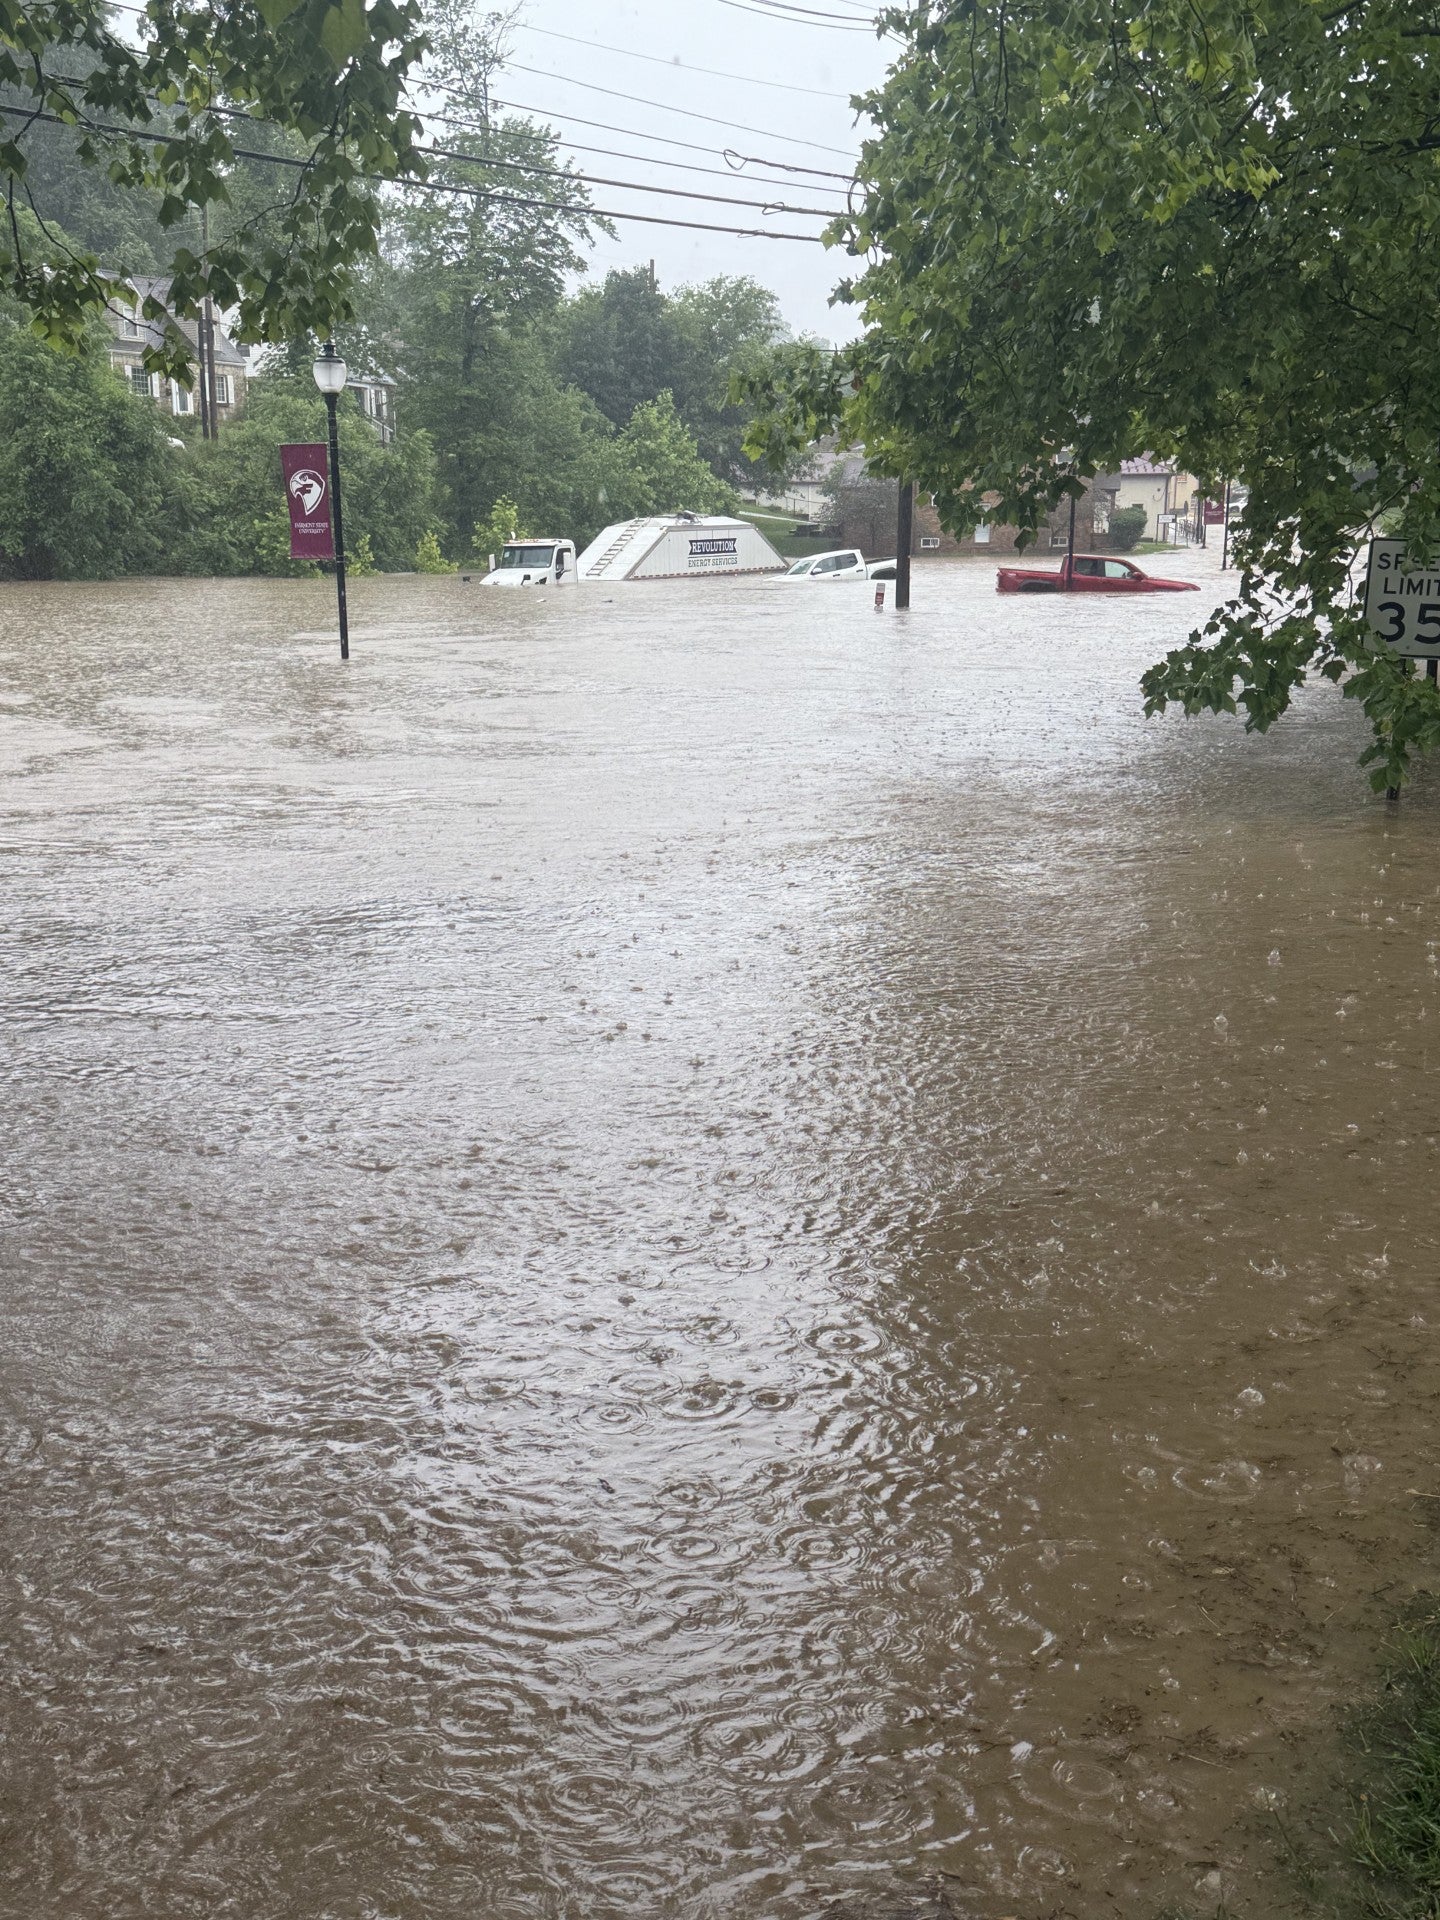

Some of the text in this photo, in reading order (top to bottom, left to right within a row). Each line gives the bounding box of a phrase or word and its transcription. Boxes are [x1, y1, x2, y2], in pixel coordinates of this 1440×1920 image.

[691, 540, 734, 553] REVOLUTION
[688, 557, 738, 567] ENERGY SERVICES
[1375, 601, 1440, 644] 35
